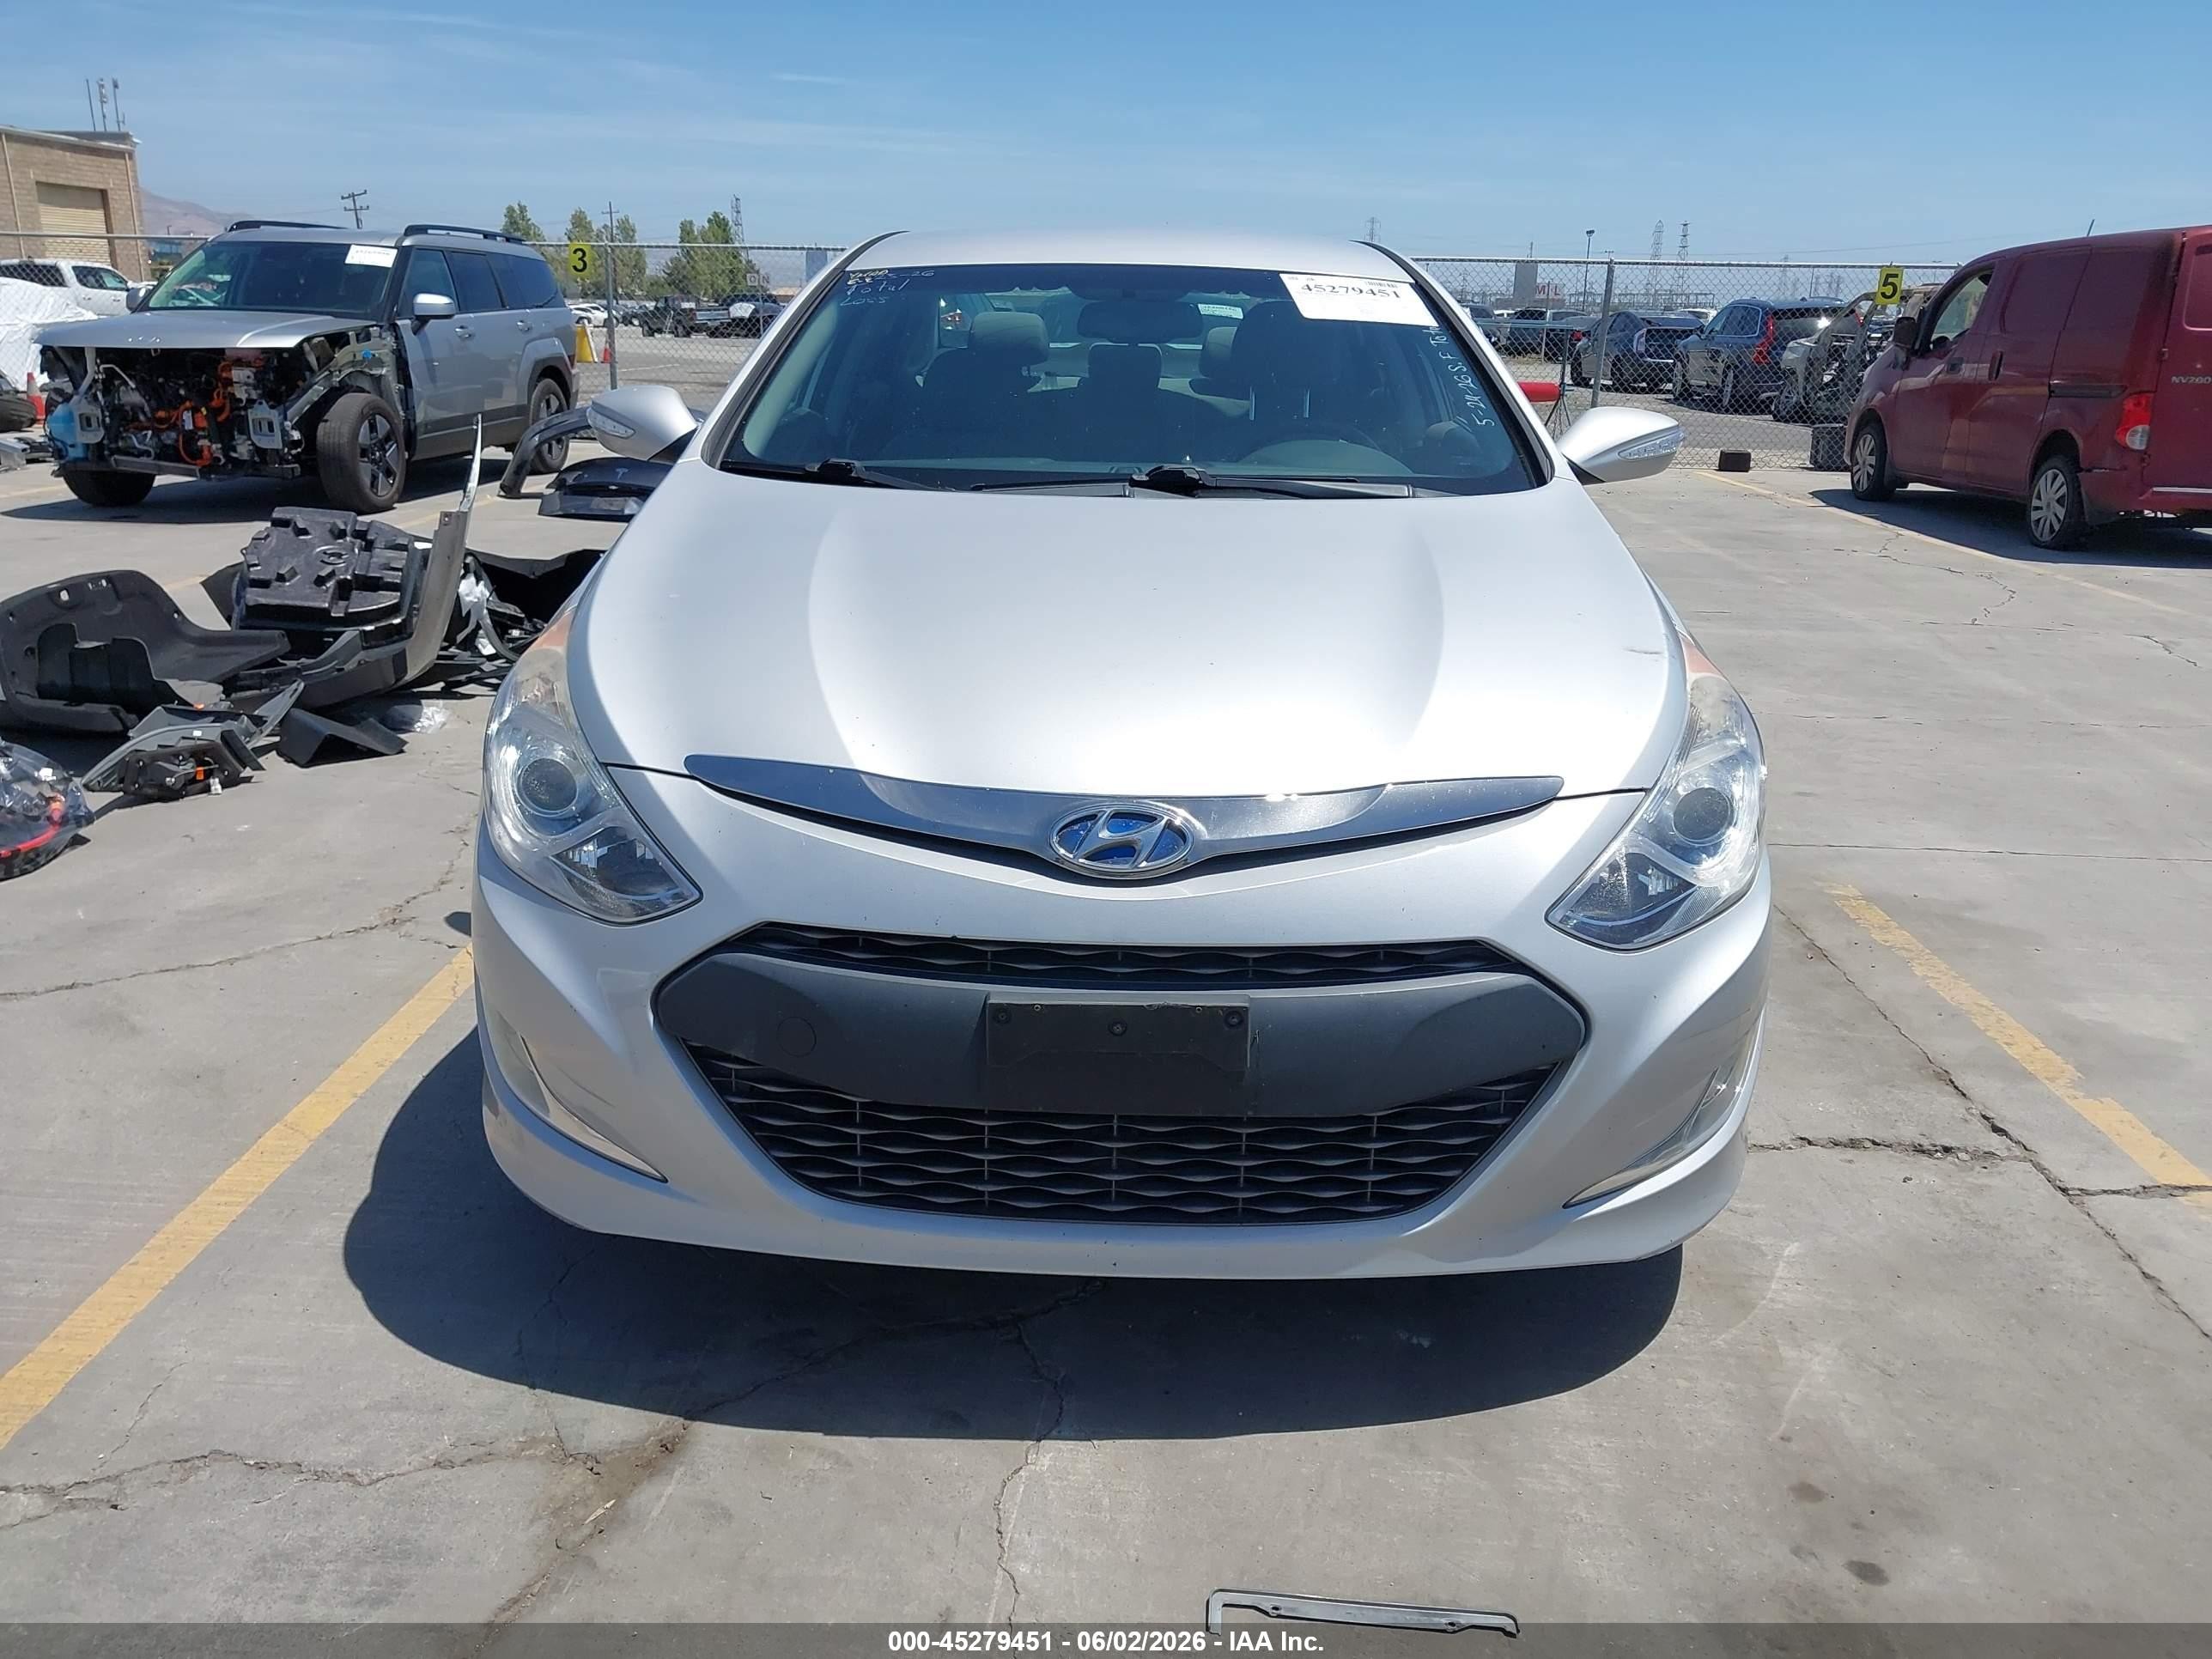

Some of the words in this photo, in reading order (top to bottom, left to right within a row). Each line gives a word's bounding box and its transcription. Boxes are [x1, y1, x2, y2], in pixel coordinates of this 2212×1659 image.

[572, 248, 587, 272] 3
[1301, 283, 1401, 299] 45279451
[1881, 273, 1899, 300] 5
